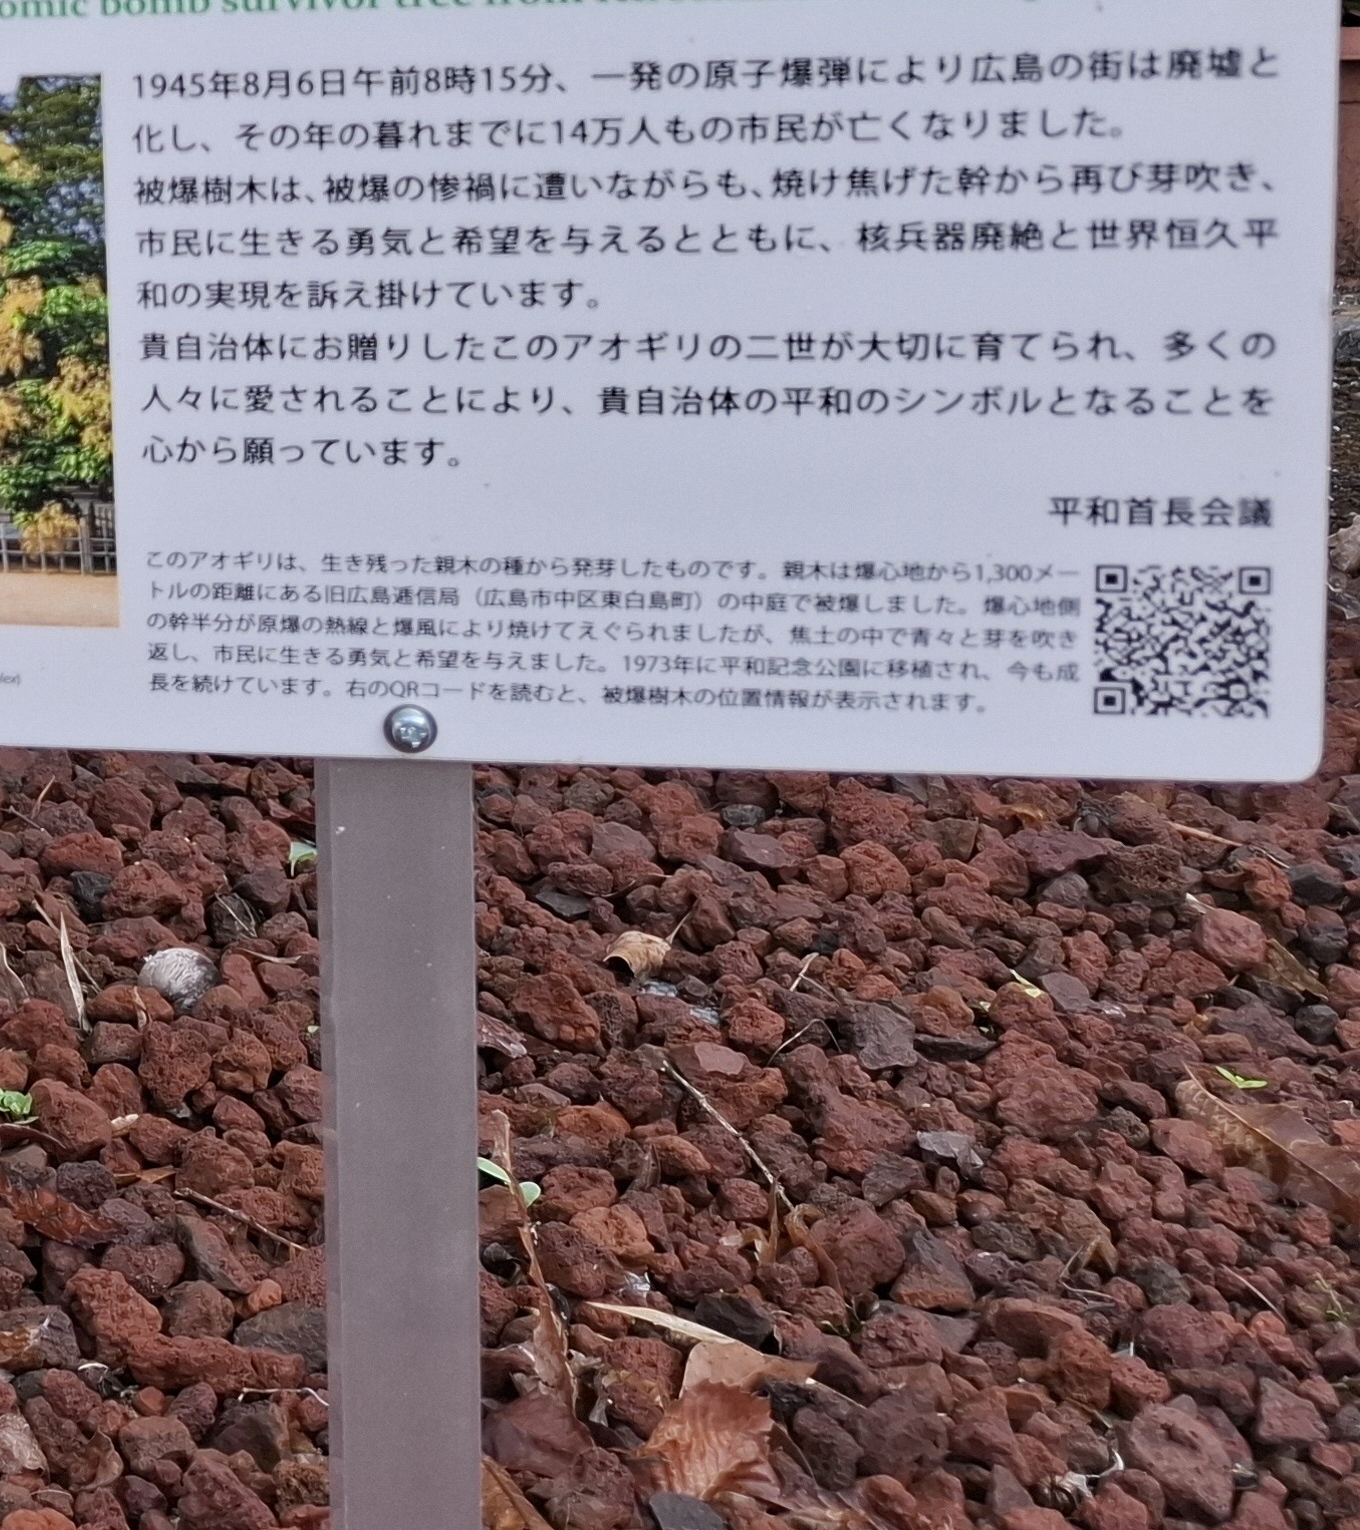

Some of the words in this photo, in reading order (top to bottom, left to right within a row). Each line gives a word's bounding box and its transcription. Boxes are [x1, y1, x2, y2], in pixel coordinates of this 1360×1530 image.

[132, 47, 1279, 100] 1945年8月6日午前8時15分、一発の原子爆弾により広島の街は廃墟と
[132, 108, 1123, 153] 化し、その年の暮れまでに14万人もの市民が亡くなりました。
[133, 161, 1275, 206] 被爆樹木は、被爆の惨禍に遭いながらも、焼け焦げた幹から再び芽吹き、
[135, 217, 1278, 258] 市民に生きる勇気と希望を与えるとともに、核兵器廃絶と世界恒久平
[137, 279, 599, 310] 和の実現を訴え掛けています。
[139, 330, 1276, 362] 貴自治体にお贈りしたこのアオギリの二世が大切に育てられ、多くの
[141, 385, 1273, 416] 人々に愛されることにより、貴自治体の平和のシンボルとなることを
[143, 435, 460, 468] 心から願っています。
[1048, 496, 1274, 528] 平和首長会議
